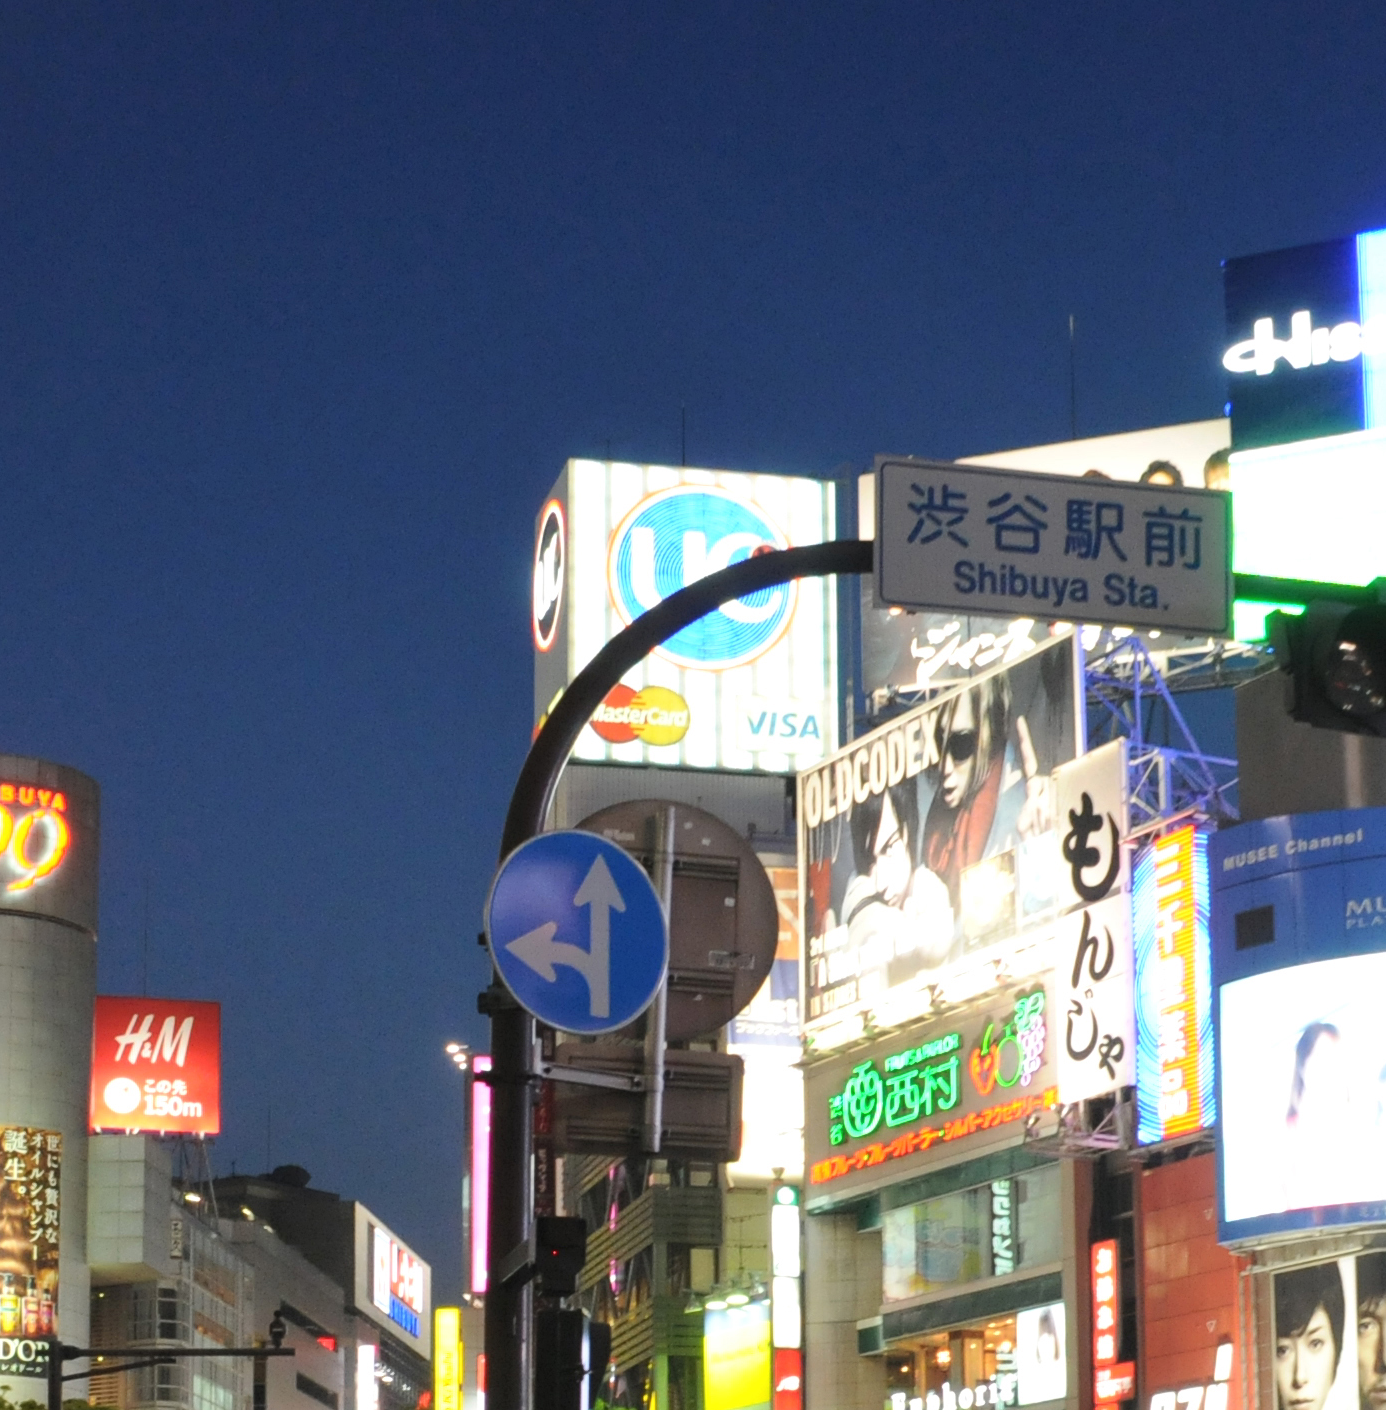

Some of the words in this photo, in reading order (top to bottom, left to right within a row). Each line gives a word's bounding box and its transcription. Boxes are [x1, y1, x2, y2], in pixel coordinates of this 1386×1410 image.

[907, 483, 1203, 571] 渋谷駅前
[954, 560, 1089, 609] Shibuya
[1103, 574, 1170, 612] Sta.
[747, 712, 820, 739] VISA
[806, 708, 941, 829] OLDCODEX
[1223, 843, 1278, 872] MUSEE
[1286, 829, 1363, 856] Channel
[1063, 791, 1125, 1080] もんじゃ
[114, 1013, 194, 1067] H&M
[143, 1095, 202, 1118] 150m
[144, 1079, 187, 1097] この先
[885, 1055, 959, 1127] 西村
[4, 1130, 28, 1195] 誕生。
[45, 1134, 61, 1244] 世にも贅沢な
[29, 1133, 44, 1261] オイルシャンプー
